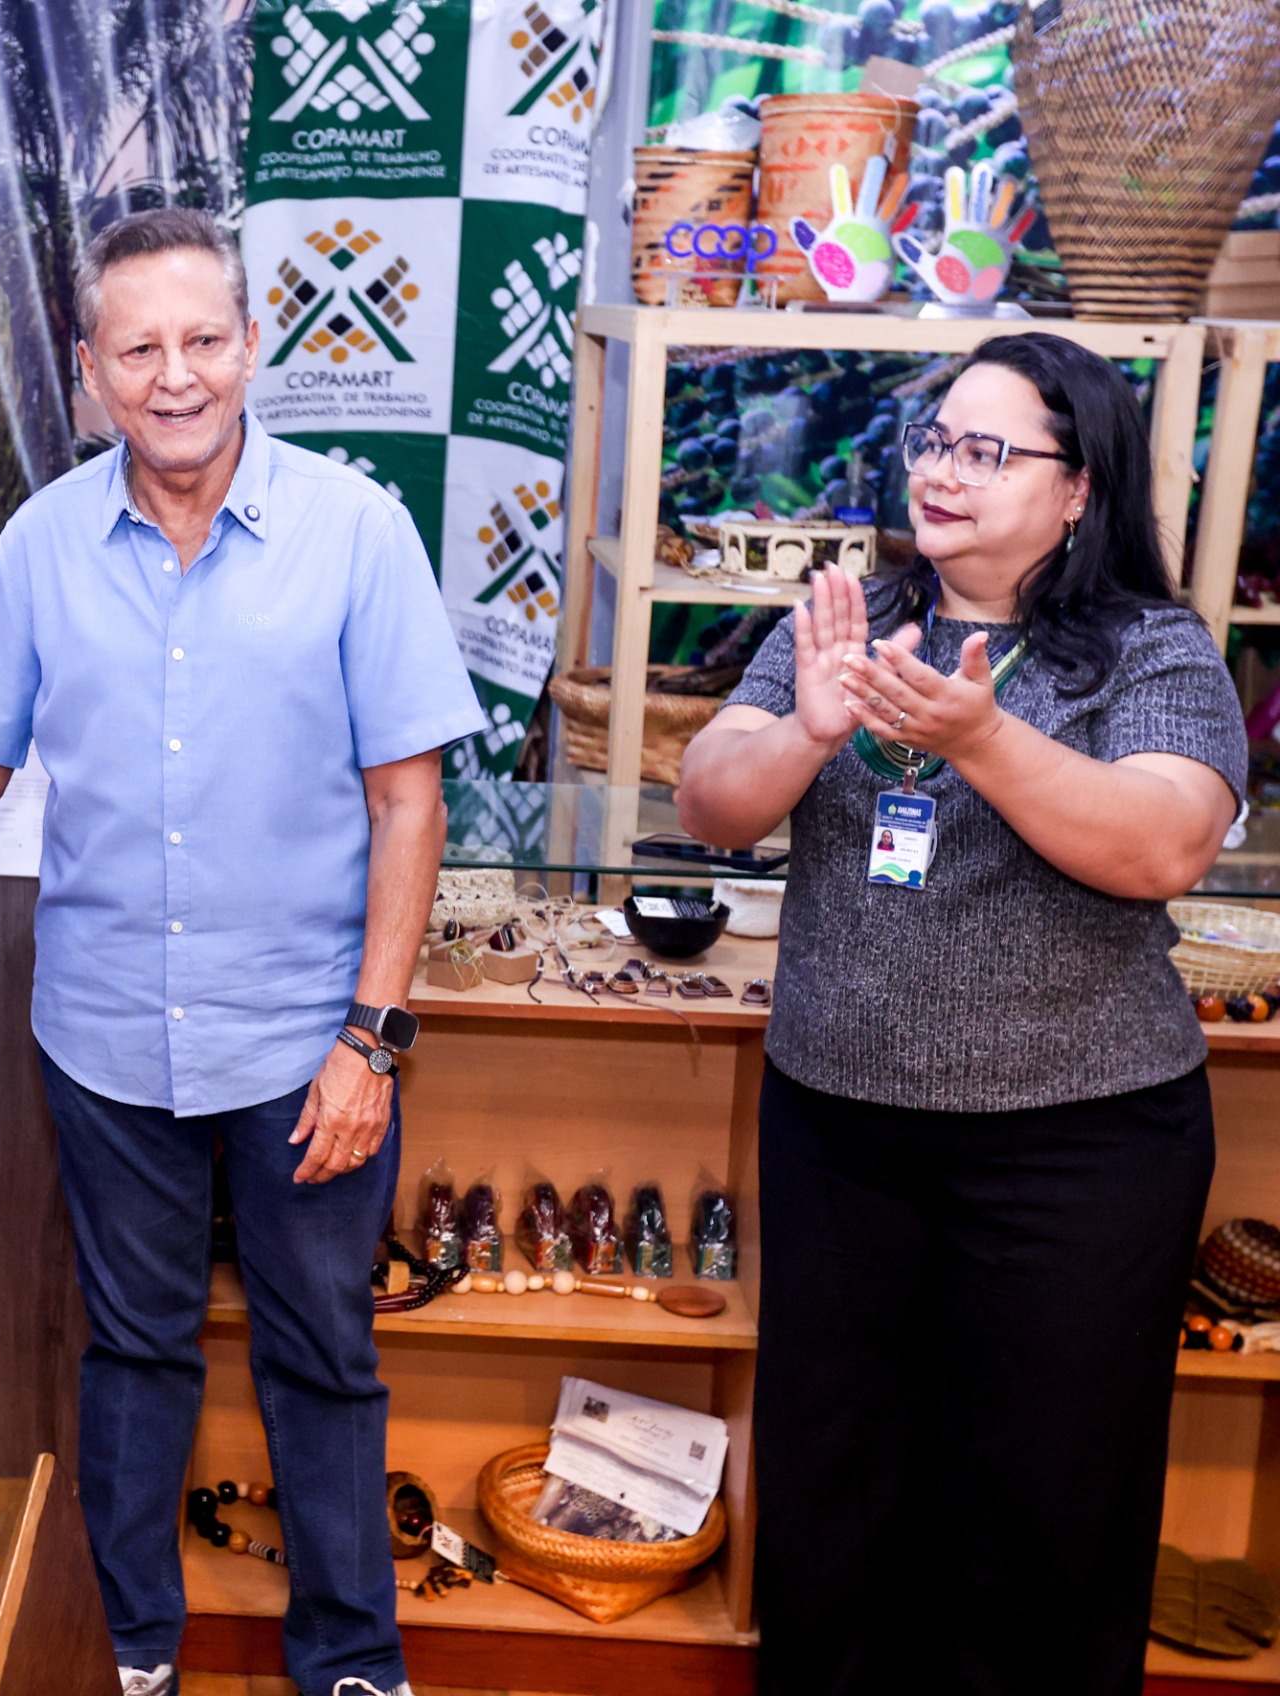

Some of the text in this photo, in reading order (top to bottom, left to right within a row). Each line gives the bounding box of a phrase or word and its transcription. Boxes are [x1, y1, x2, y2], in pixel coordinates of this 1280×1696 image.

[291, 127, 408, 149] COPAMART
[258, 149, 442, 166] COOPERATIVA DE TRABALHO
[271, 165, 353, 182] ARTESANATO
[354, 164, 447, 181] AMAZONENSE
[285, 369, 394, 390] COPAMART
[255, 391, 428, 408] COOPERATIVA DE TRABALHO
[267, 406, 344, 421] ARTESANATO
[346, 406, 433, 419] AMAZONENSE
